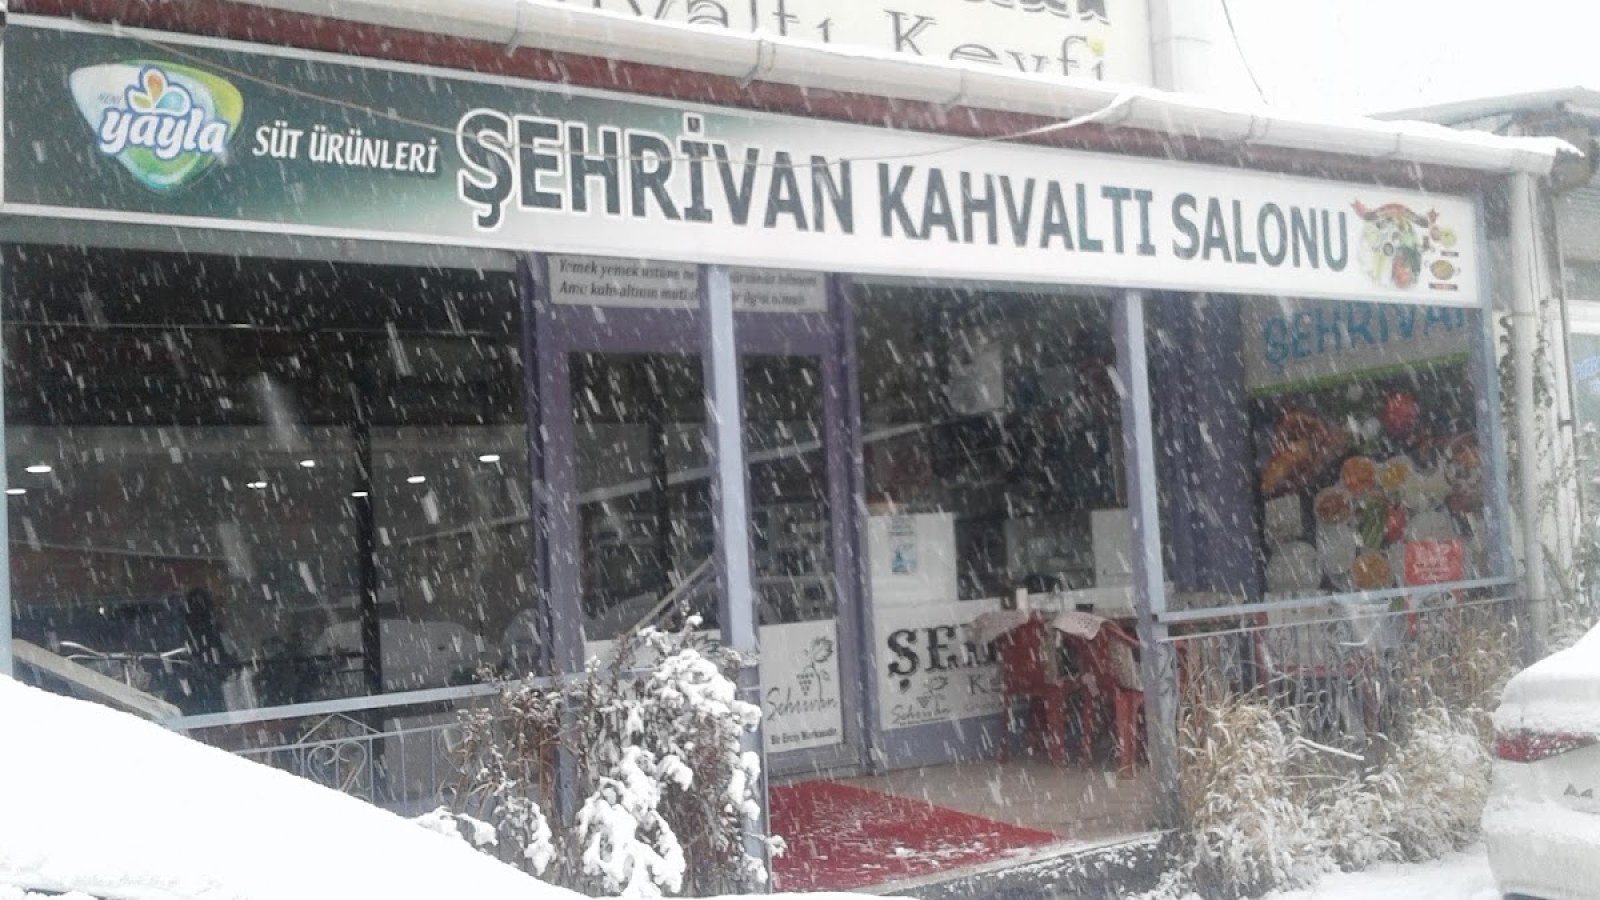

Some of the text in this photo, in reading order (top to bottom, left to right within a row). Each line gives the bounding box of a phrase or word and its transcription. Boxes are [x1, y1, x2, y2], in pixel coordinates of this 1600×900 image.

[99, 108, 230, 160] yayla
[252, 120, 440, 174] SÜT ÜRÜNLERİ
[457, 108, 1349, 272] ŞEHRİVAN KAHVALTI SALONU
[1563, 782, 1593, 799] A4
